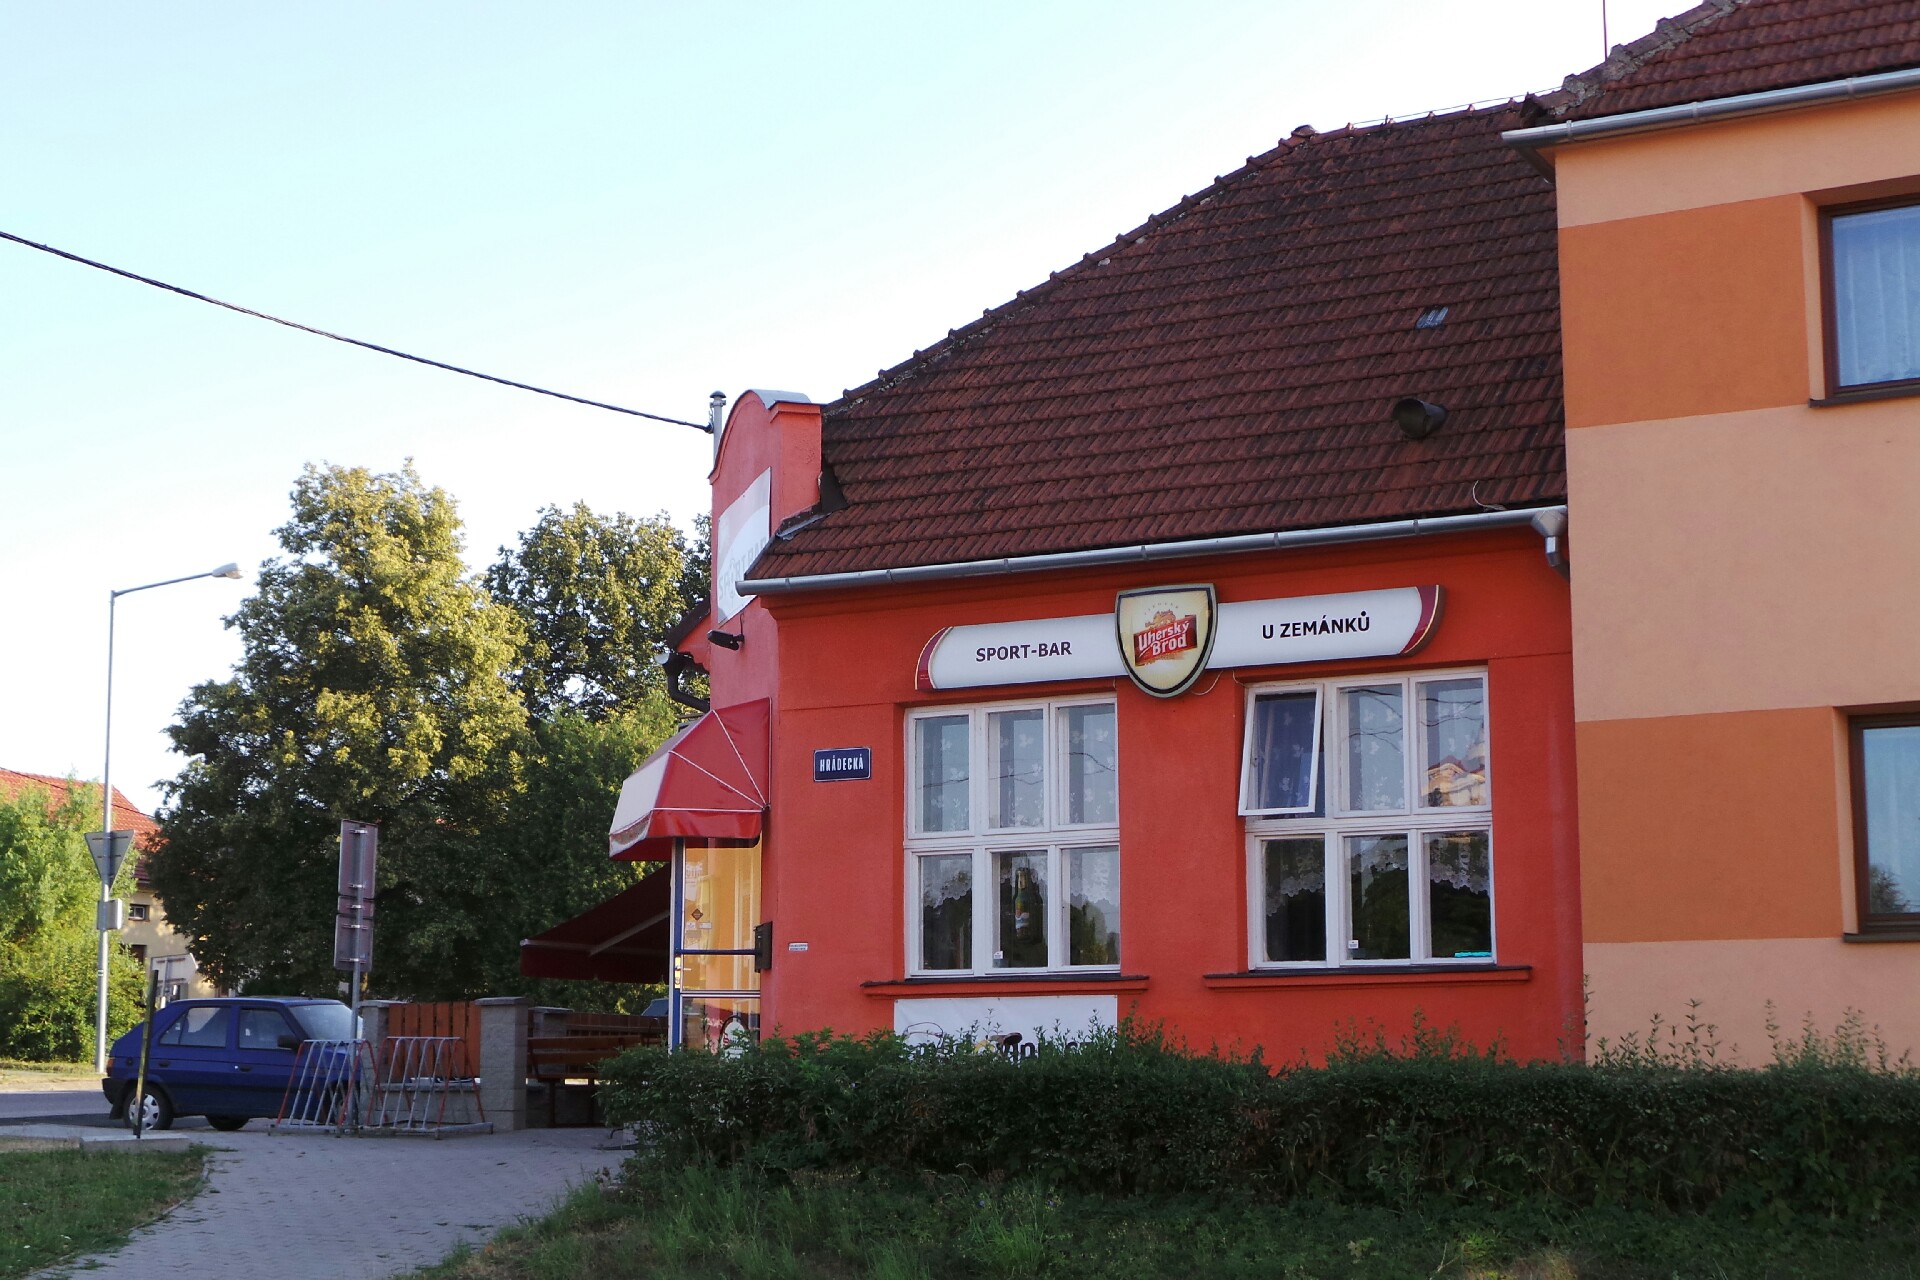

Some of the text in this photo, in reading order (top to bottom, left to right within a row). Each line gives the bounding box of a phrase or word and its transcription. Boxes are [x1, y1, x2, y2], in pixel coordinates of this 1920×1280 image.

[1138, 620, 1190, 651] Uherský
[1262, 610, 1370, 639] U ZEMÁNKŮ
[976, 641, 1072, 662] SPORT-BAR
[1152, 633, 1188, 656] Brod
[820, 753, 864, 772] HRÁDECKÁ
